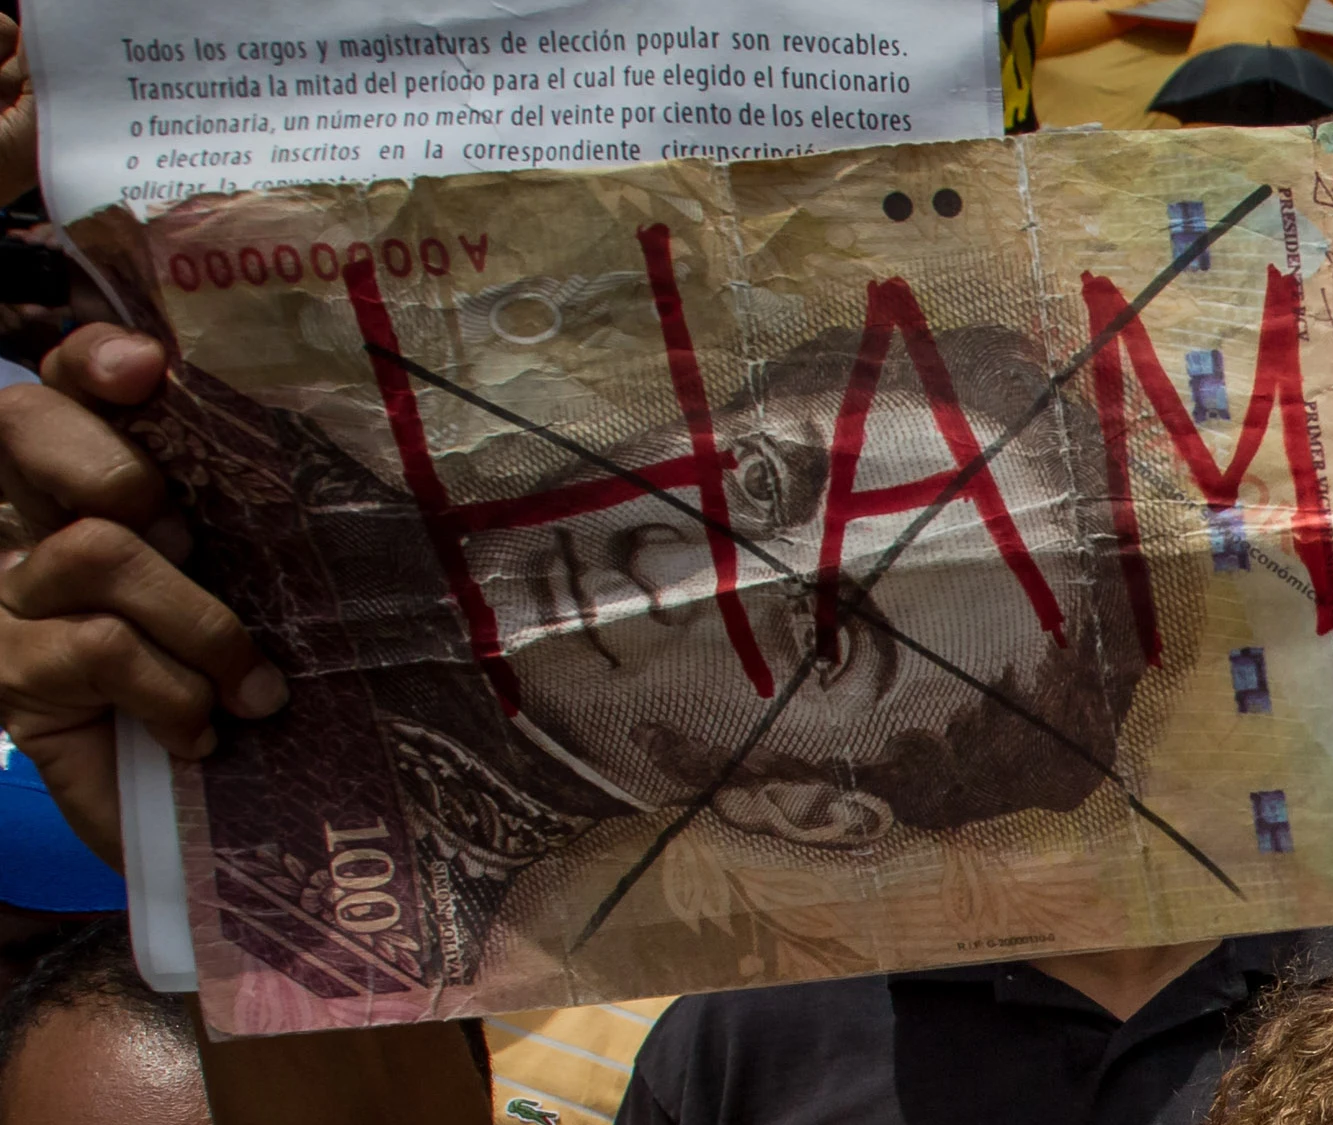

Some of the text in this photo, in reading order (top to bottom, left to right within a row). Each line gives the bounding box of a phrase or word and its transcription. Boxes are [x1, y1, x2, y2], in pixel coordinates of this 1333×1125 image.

[121, 26, 908, 66] Todos los cargos y magistraturas de elección popular son revocables.
[127, 63, 911, 101] Transcurrida la mitad del período para el cual fue elegido el funcionario
[130, 102, 912, 138] o funcionaria, un número no menor del veinte por ciento de los electores
[126, 153, 139, 170] o
[156, 149, 252, 169] electoras
[271, 143, 361, 164] inscritos
[379, 143, 406, 160] en
[424, 139, 444, 160] la
[463, 138, 641, 168] correspondiente
[1303, 399, 1327, 472] PRIMER
[322, 815, 402, 934] 100
